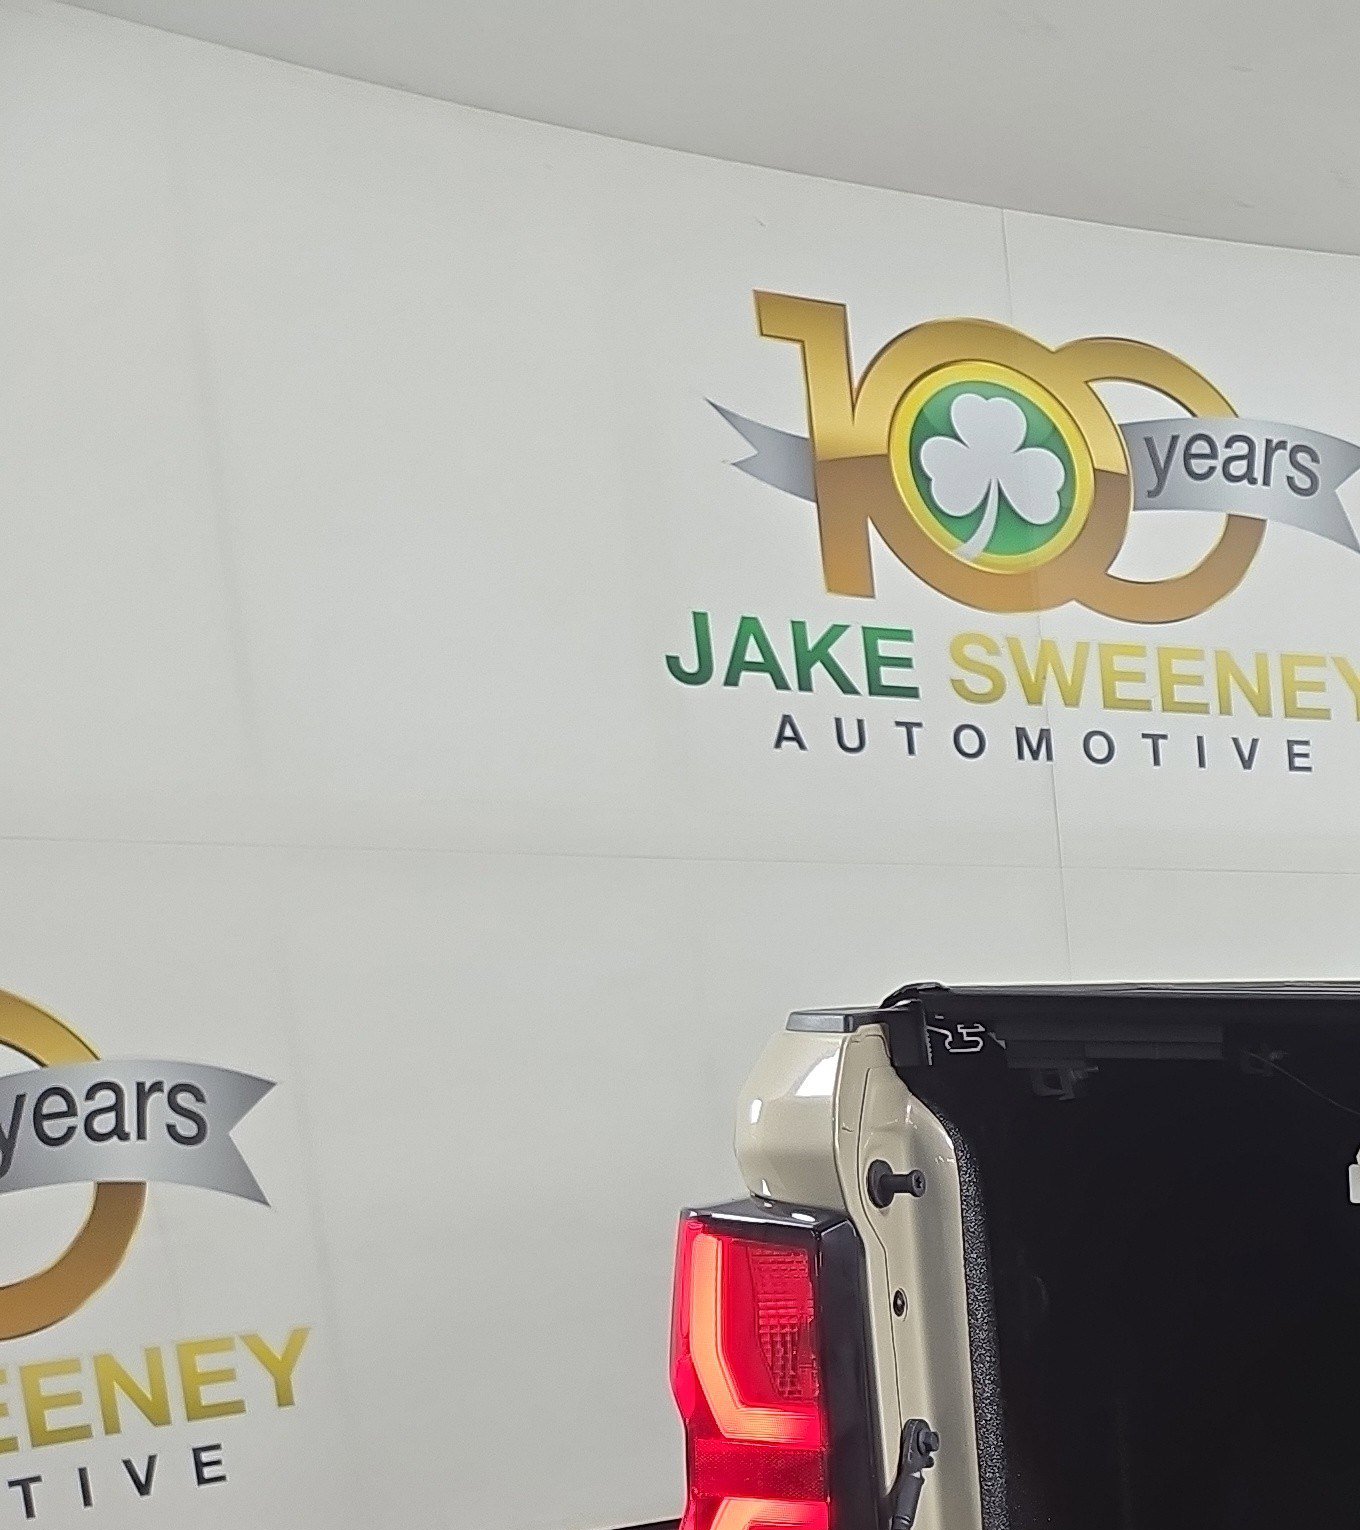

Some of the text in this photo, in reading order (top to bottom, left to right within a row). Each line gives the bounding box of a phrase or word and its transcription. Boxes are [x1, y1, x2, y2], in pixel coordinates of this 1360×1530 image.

[753, 289, 1321, 625] 100 years
[665, 610, 920, 699] JAKE
[773, 713, 1314, 773] AUTOMOTIVE
[0, 1326, 310, 1456] ENEY
